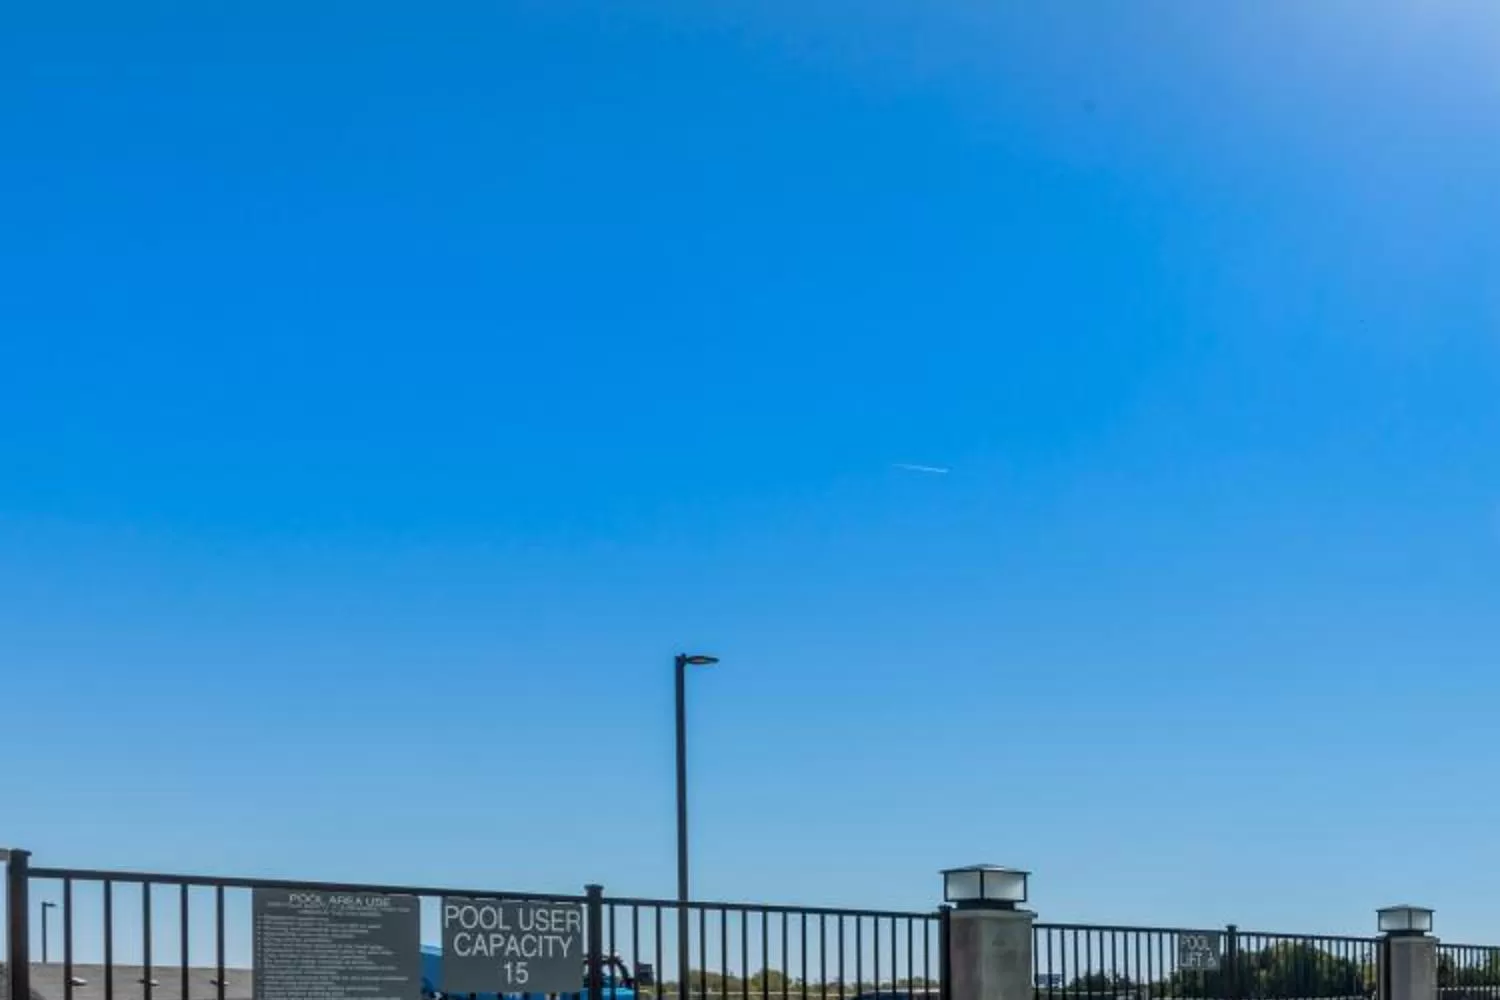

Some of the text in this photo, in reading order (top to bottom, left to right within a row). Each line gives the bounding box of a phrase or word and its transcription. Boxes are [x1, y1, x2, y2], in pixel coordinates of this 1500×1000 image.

[445, 905, 581, 934] POOL USER
[453, 932, 572, 958] CAPACITY
[1181, 934, 1209, 950] POOL
[1180, 951, 1203, 967] LIFT
[503, 961, 529, 985] 15
